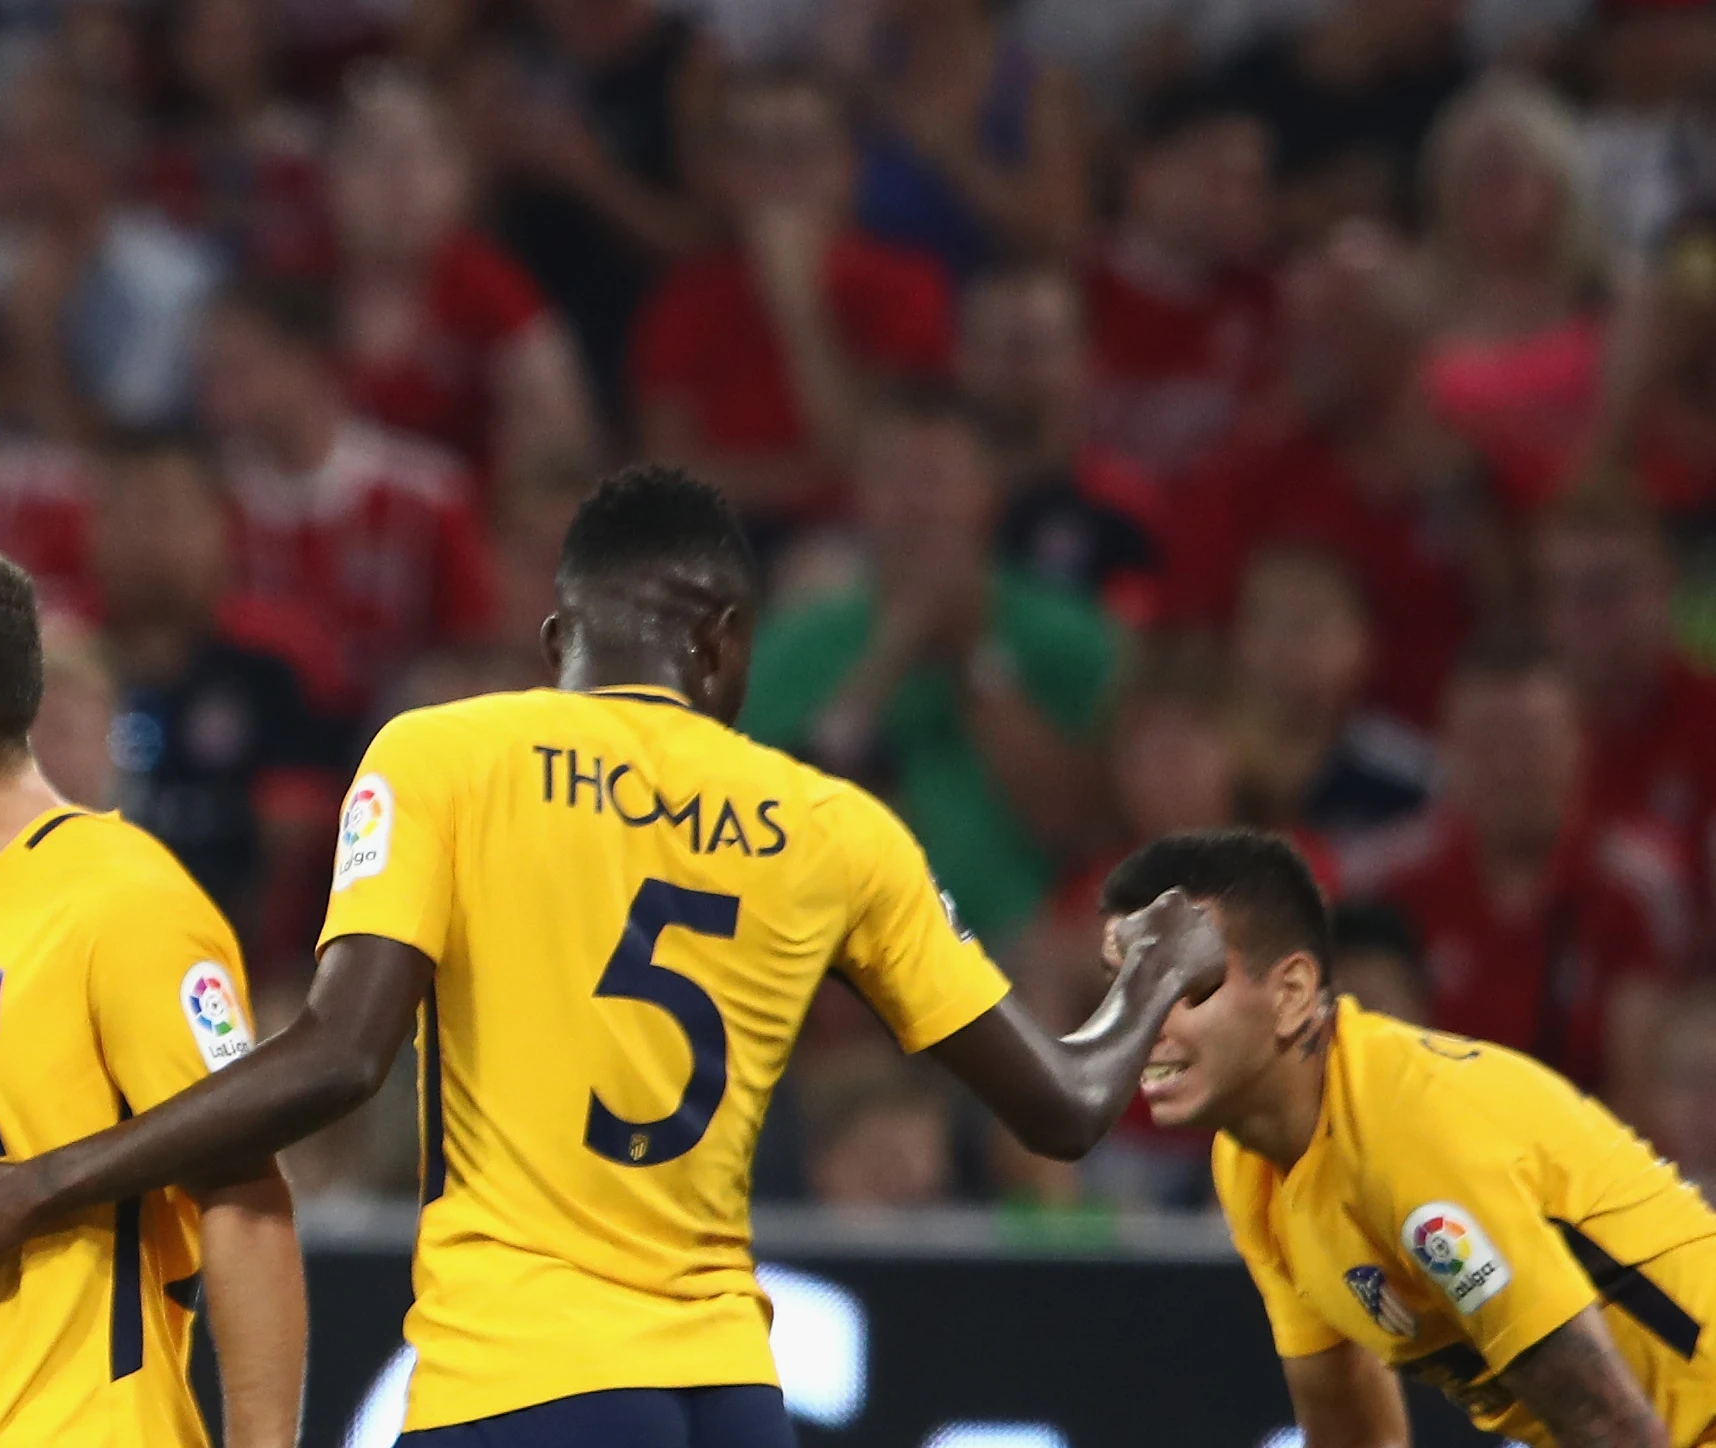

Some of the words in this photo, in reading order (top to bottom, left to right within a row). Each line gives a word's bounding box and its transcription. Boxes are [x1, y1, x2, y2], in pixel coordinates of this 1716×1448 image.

[532, 745, 787, 857] THOMAS
[208, 1040, 248, 1058] LaLig
[583, 876, 741, 1169] 5
